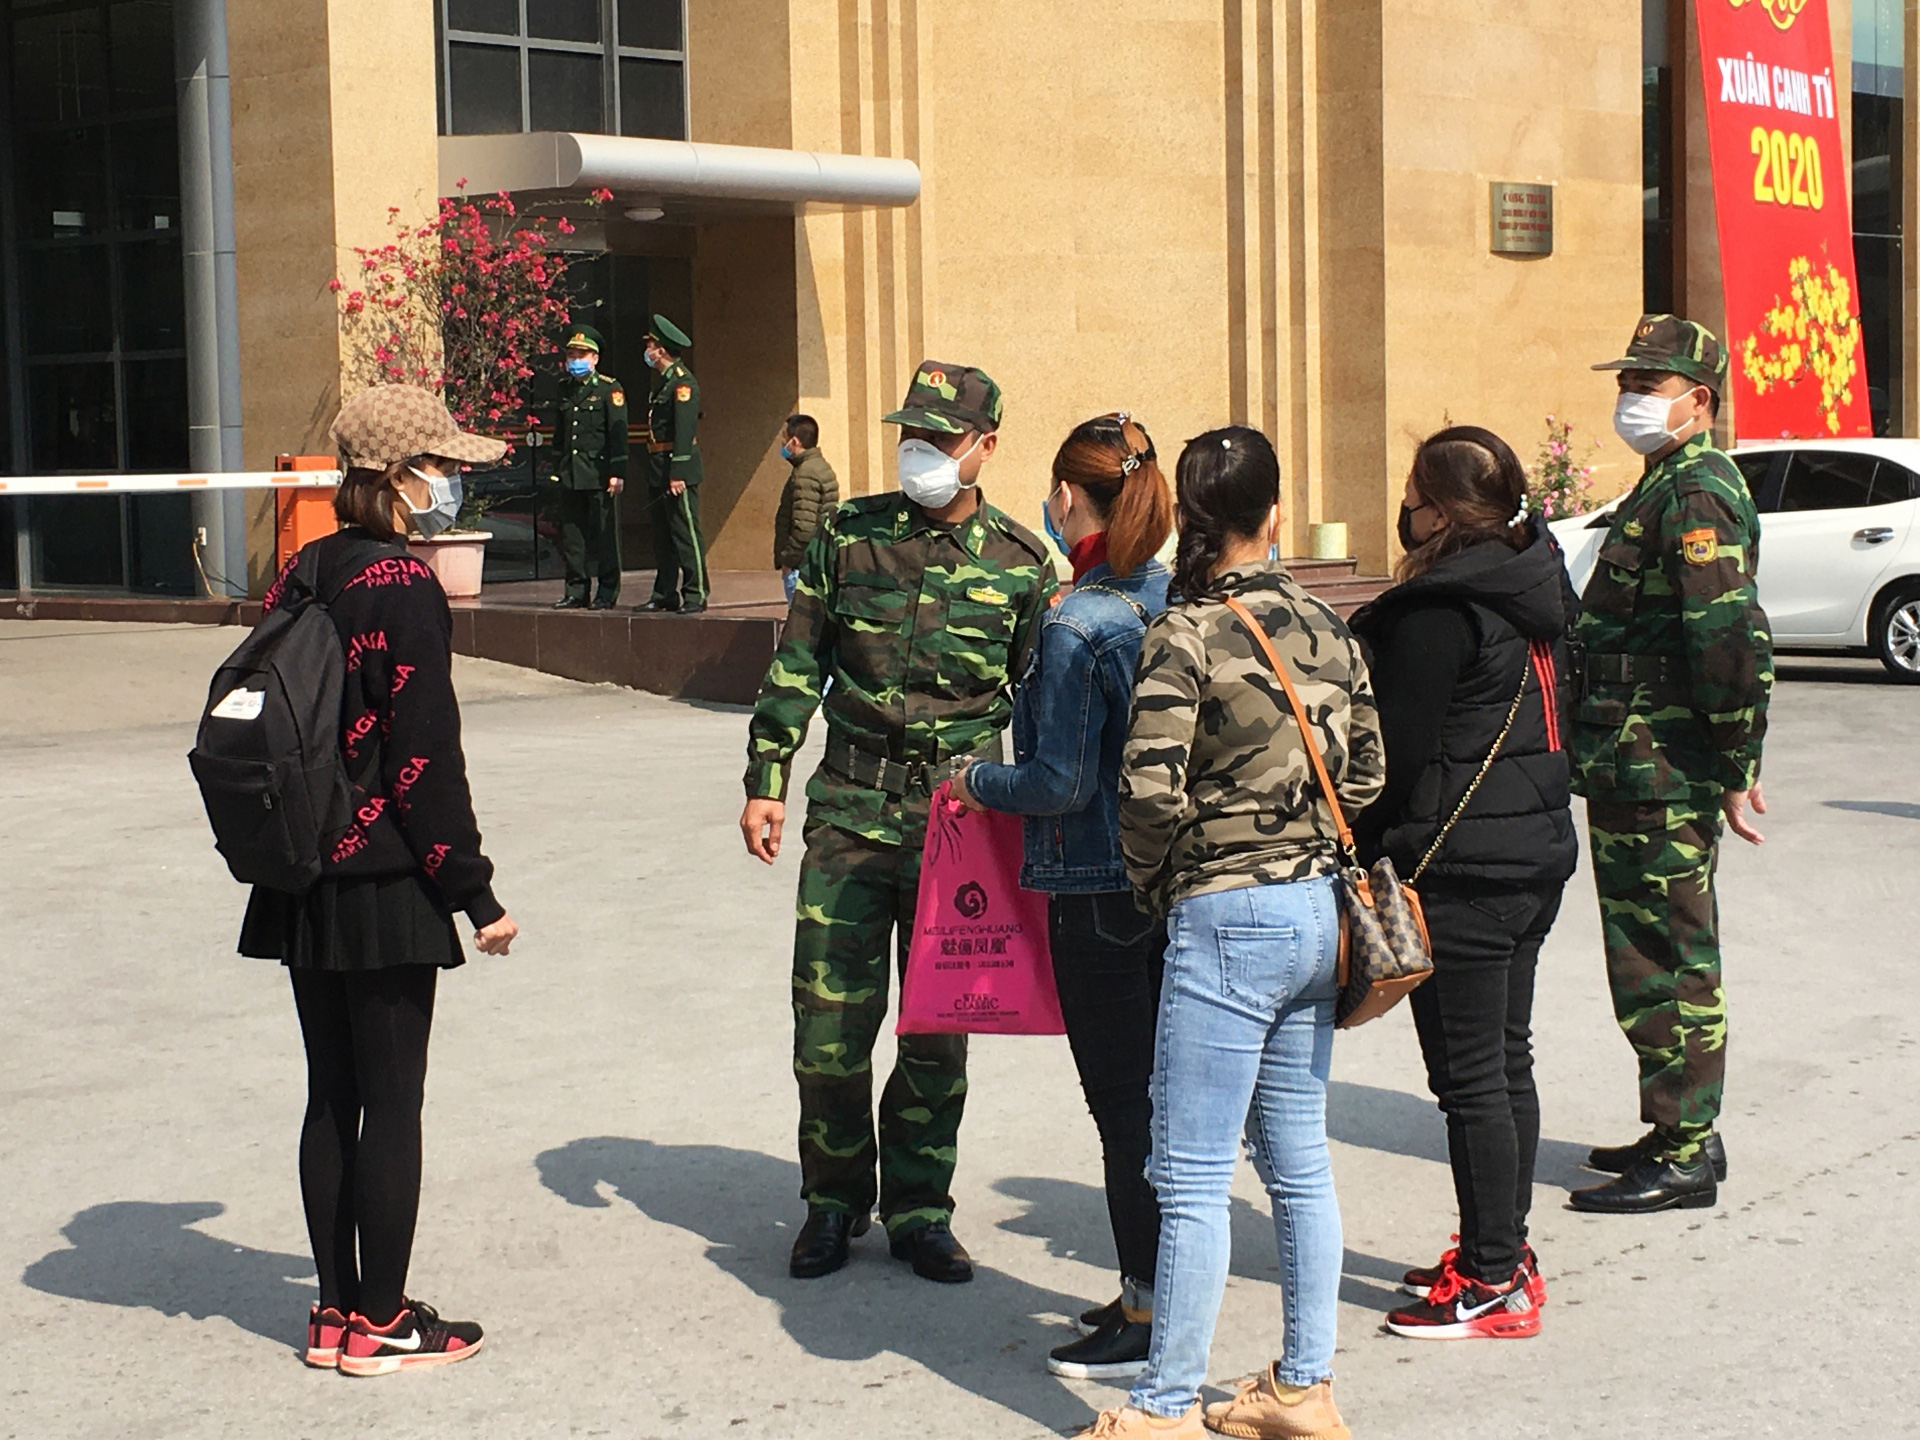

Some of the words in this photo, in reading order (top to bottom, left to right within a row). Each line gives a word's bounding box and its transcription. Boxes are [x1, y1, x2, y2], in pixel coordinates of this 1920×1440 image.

[1717, 51, 1771, 107] XUÂN
[1773, 66, 1812, 116] CANH
[1750, 126, 1824, 210] 2020
